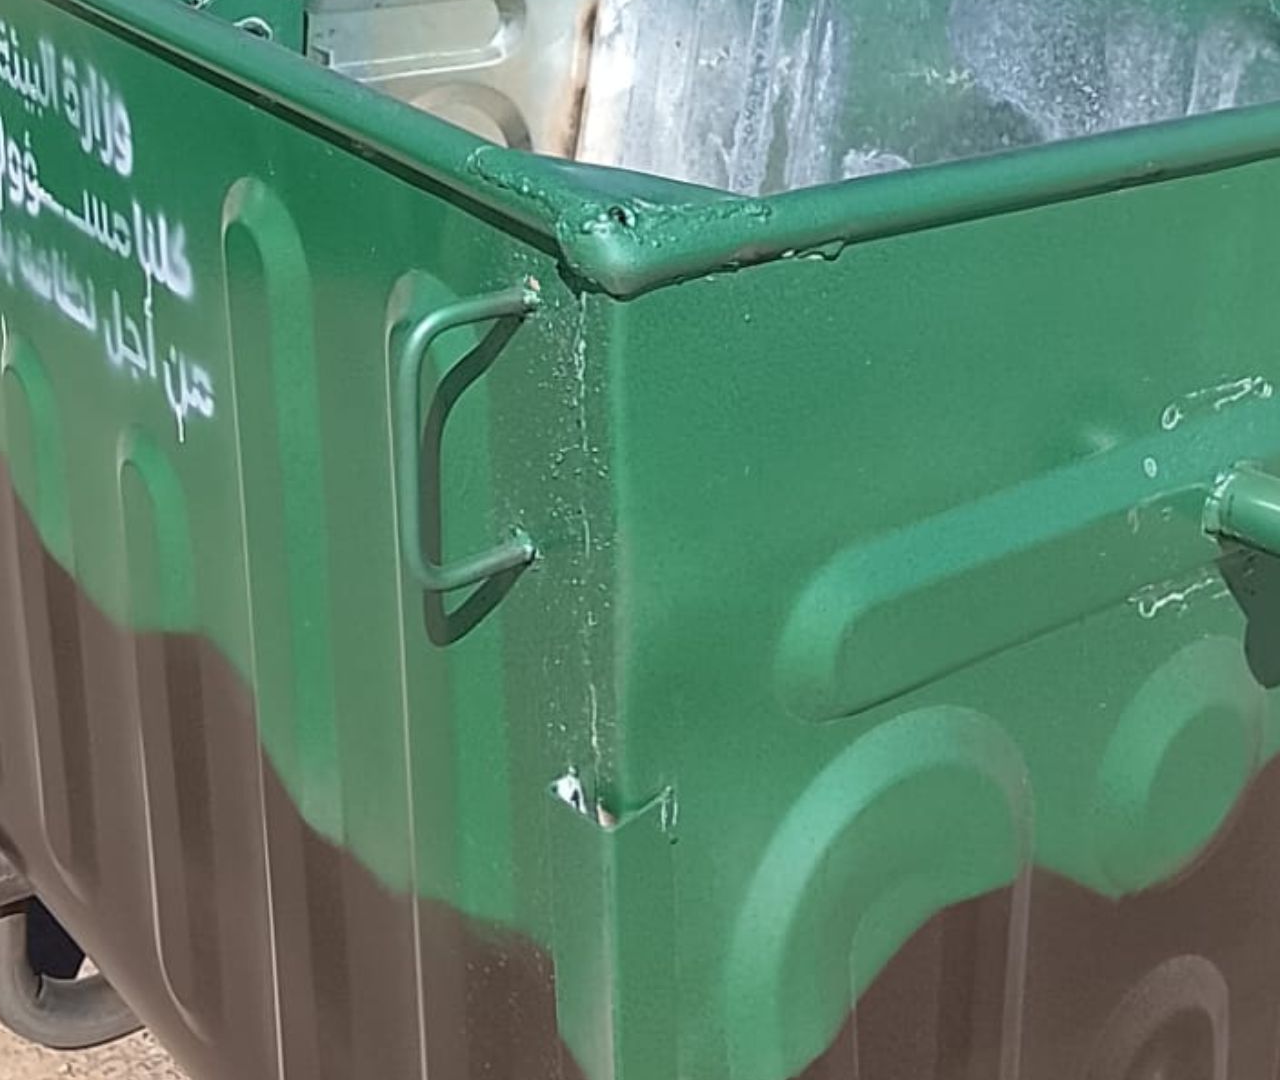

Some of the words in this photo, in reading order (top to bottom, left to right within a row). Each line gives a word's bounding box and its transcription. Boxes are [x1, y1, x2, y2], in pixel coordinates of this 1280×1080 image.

[62, 55, 134, 177] وزارة
[131, 197, 195, 302] كلنا
[103, 289, 157, 380] أجل
[163, 344, 215, 423] من
